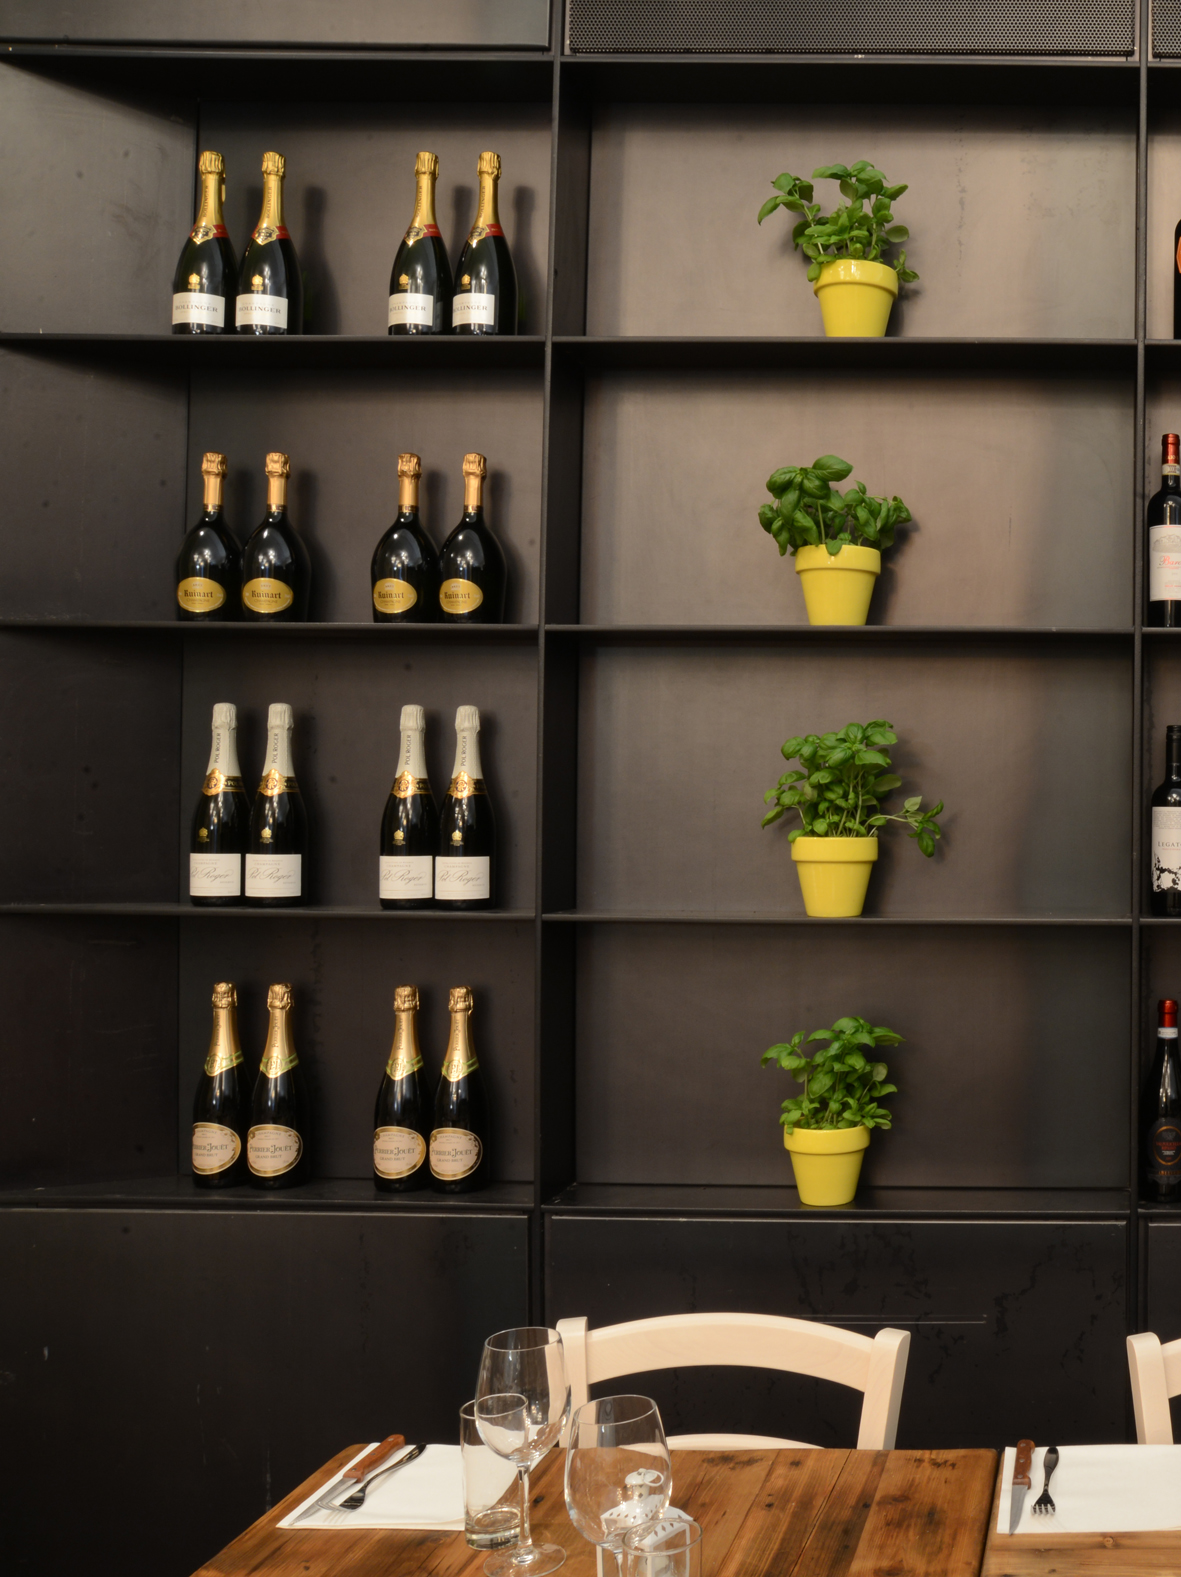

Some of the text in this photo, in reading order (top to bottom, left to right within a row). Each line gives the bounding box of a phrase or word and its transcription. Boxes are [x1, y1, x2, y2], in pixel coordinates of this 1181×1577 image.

[175, 304, 218, 313] BOLLINGER
[239, 305, 281, 315] BOLLINGER
[184, 589, 213, 598] Ruinart
[251, 590, 282, 599] Ruinart
[378, 591, 404, 599] Ruinart
[444, 591, 470, 600] Ruinart
[198, 866, 231, 882] Roger
[260, 866, 293, 883] Roger
[391, 869, 424, 885] Roger
[450, 869, 481, 886] Roger
